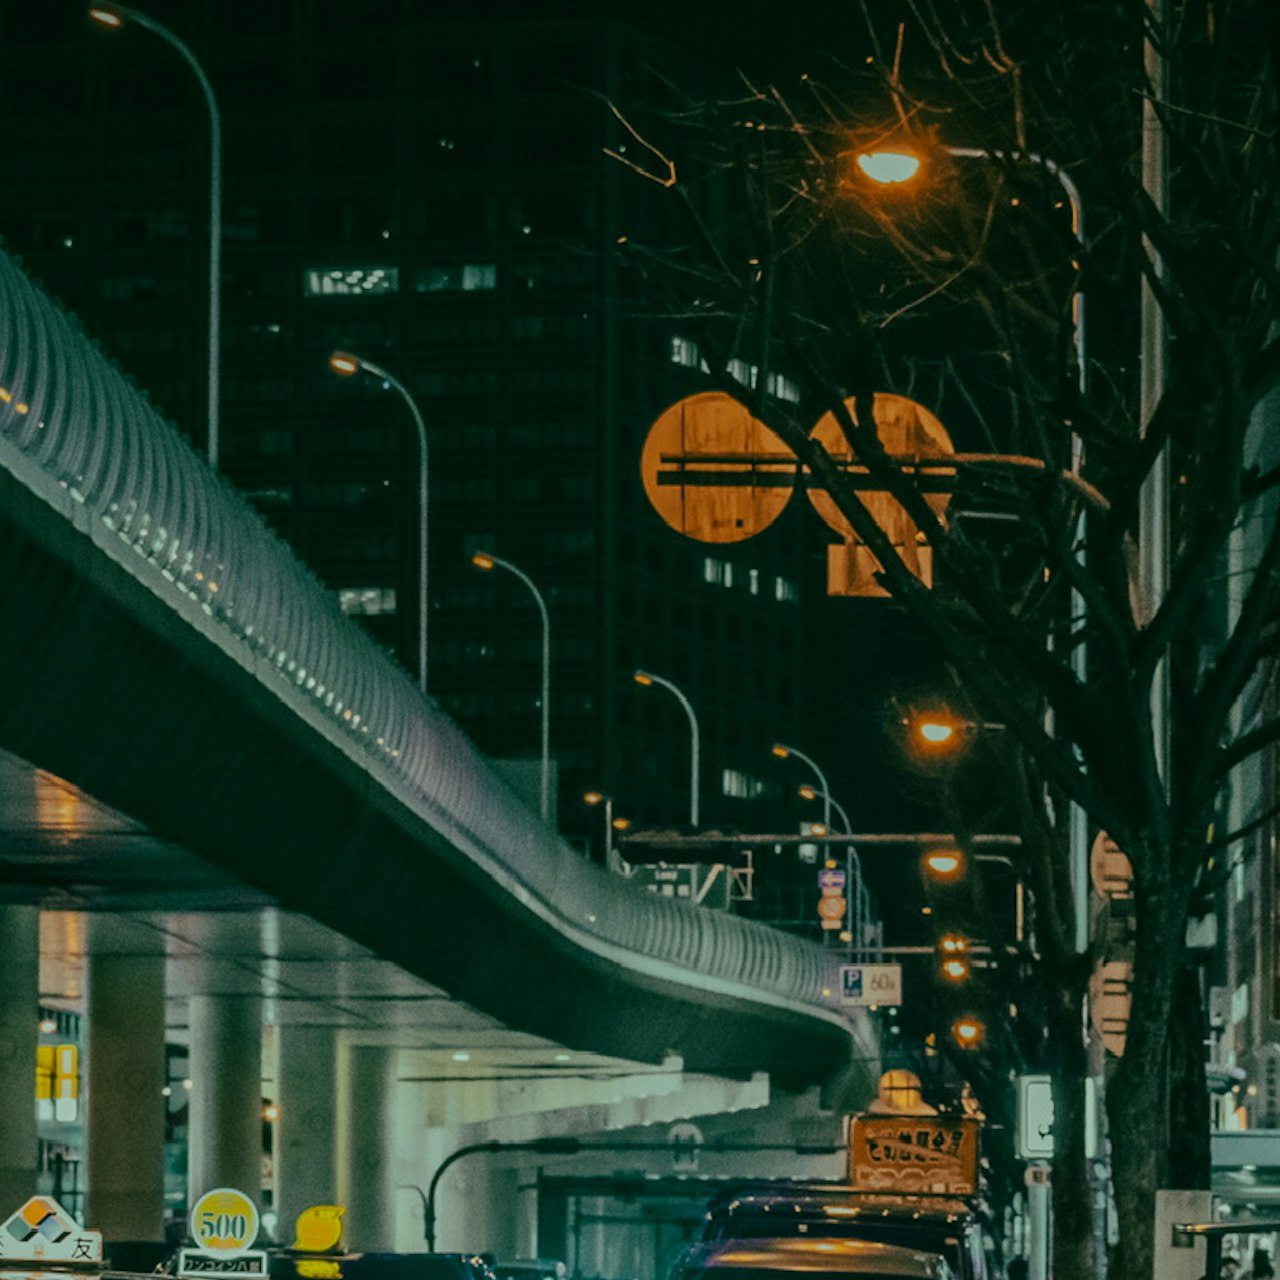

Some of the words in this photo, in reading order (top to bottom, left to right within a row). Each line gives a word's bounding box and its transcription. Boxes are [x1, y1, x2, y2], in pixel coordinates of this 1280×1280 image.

[847, 970, 860, 988] P
[200, 1212, 245, 1241] 500
[71, 1237, 94, 1260] 友
